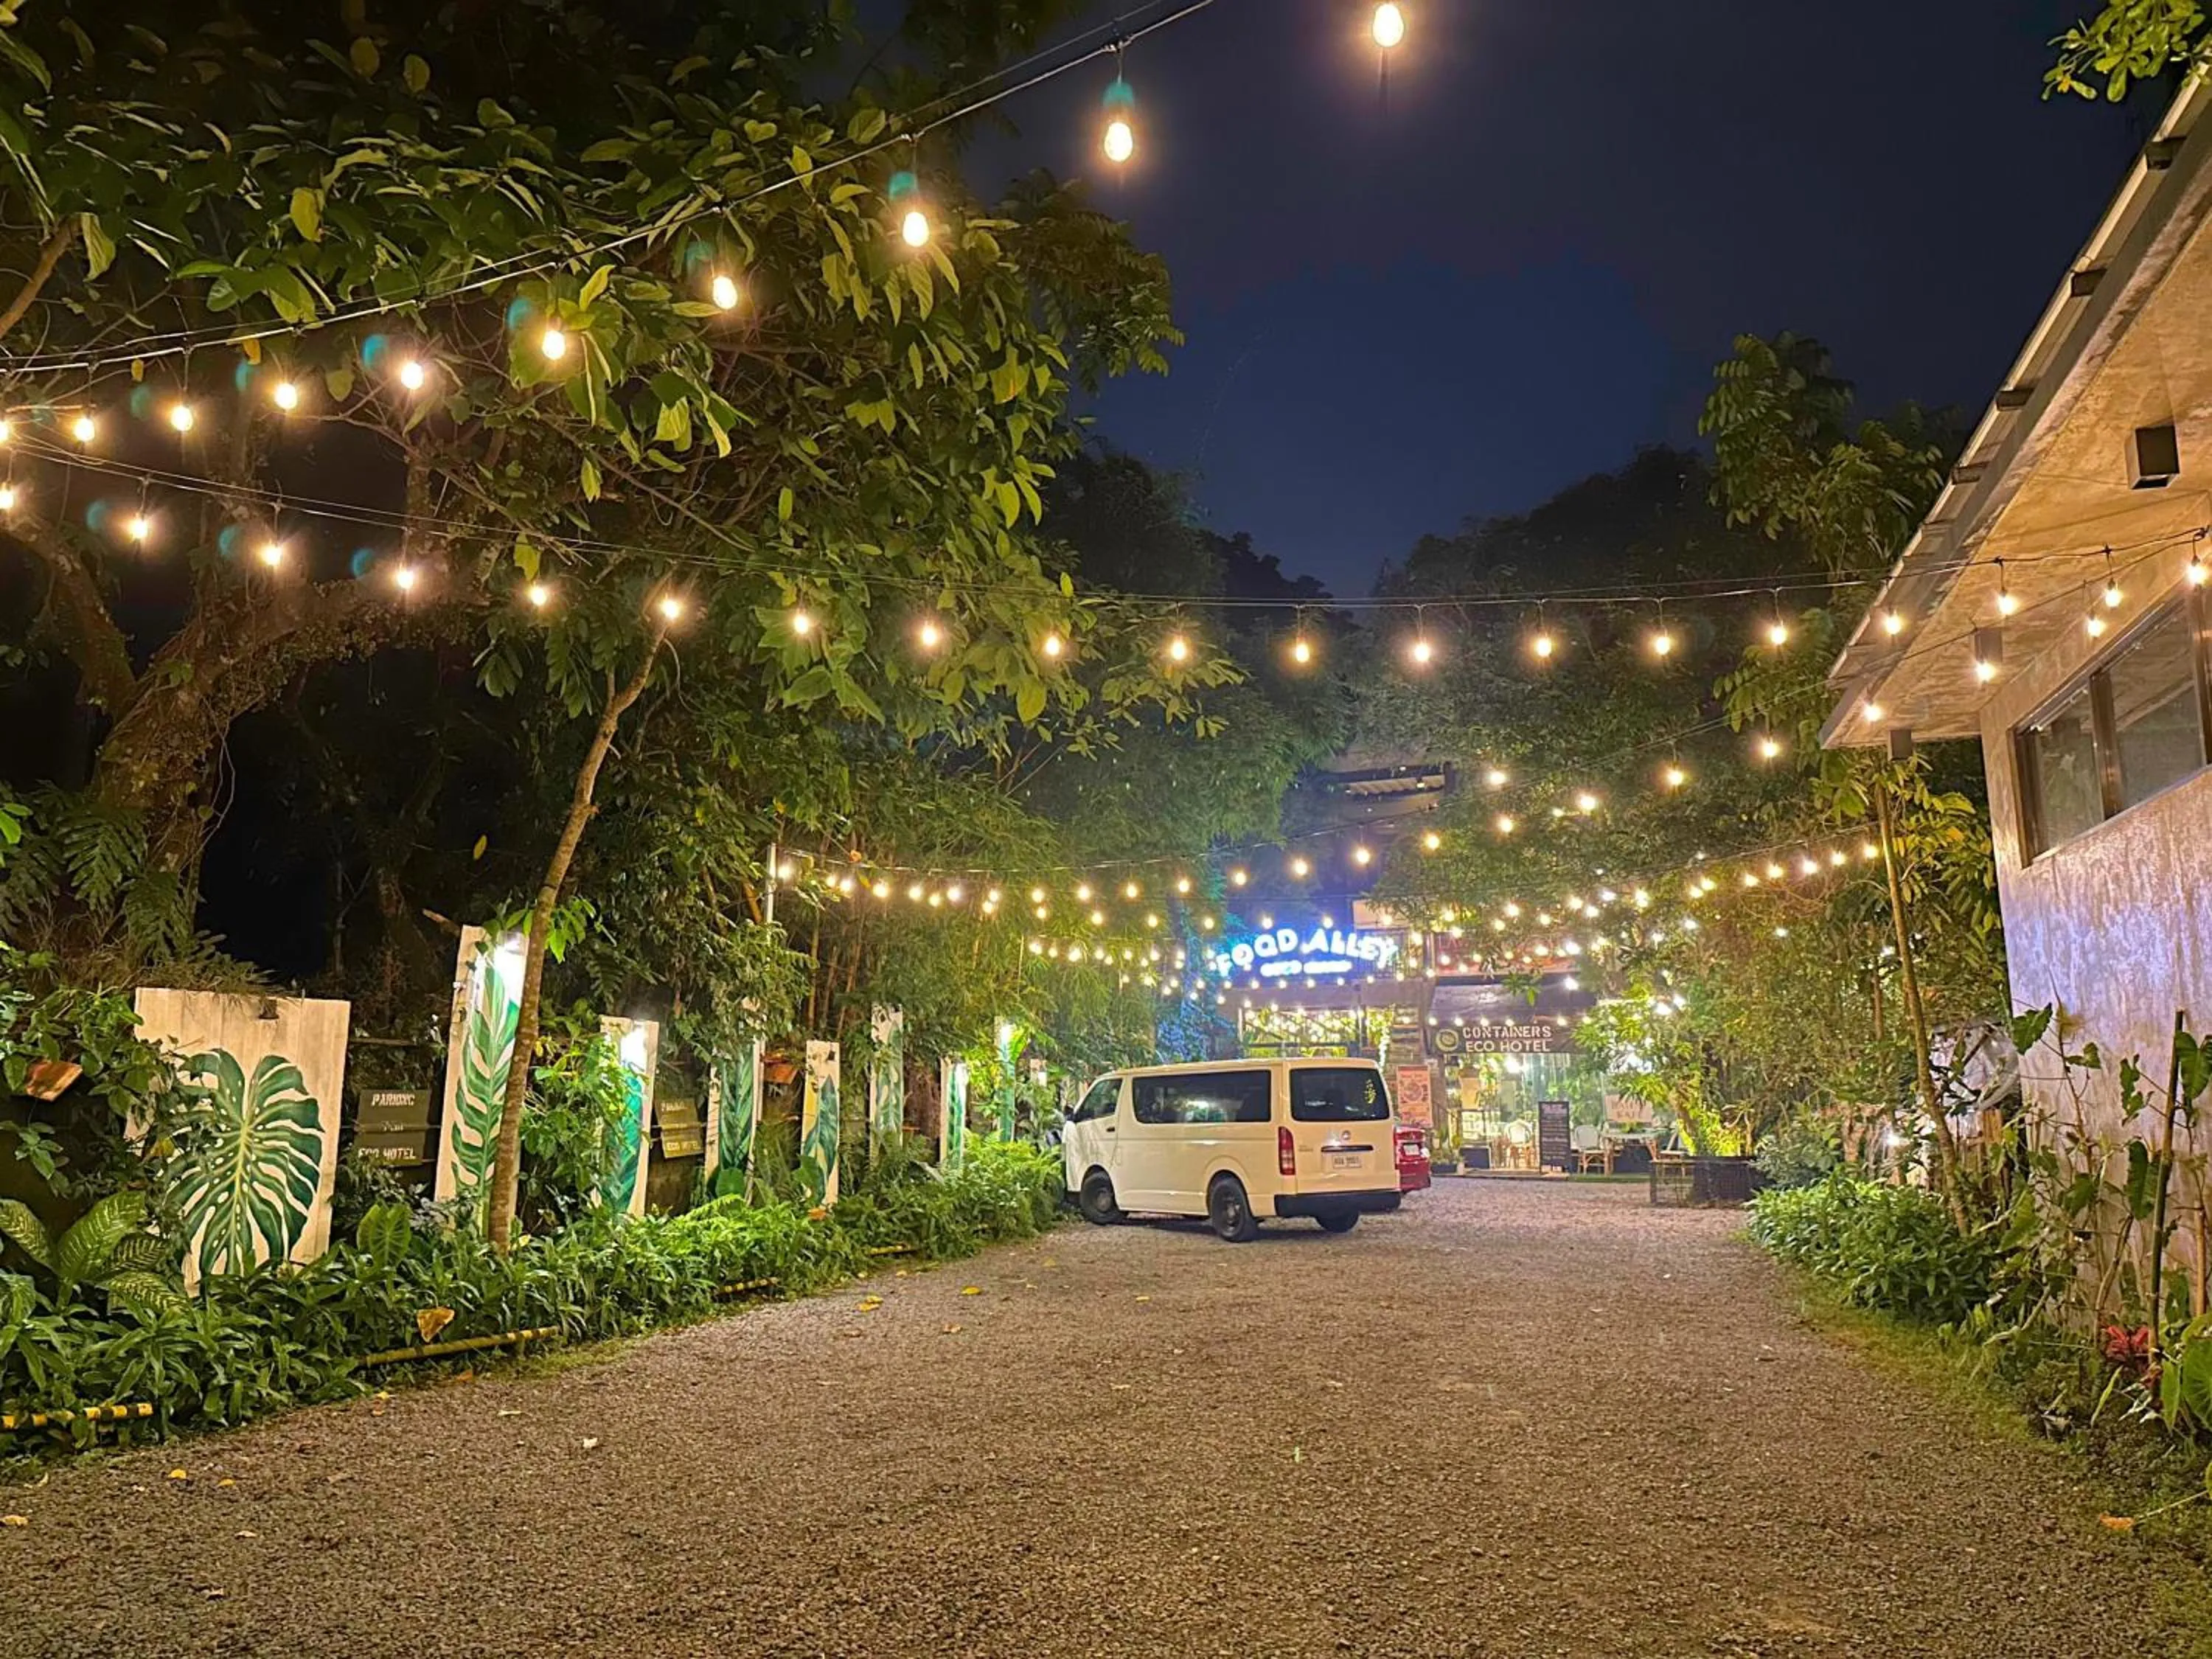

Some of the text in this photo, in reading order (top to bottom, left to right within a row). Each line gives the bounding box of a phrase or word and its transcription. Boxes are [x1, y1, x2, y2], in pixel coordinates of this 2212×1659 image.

[1217, 928, 1298, 977] FOOD
[1307, 928, 1399, 969] ALLEY
[1462, 1026, 1551, 1039] CONTAINERS
[1465, 1040, 1551, 1052] ECO HOTEL
